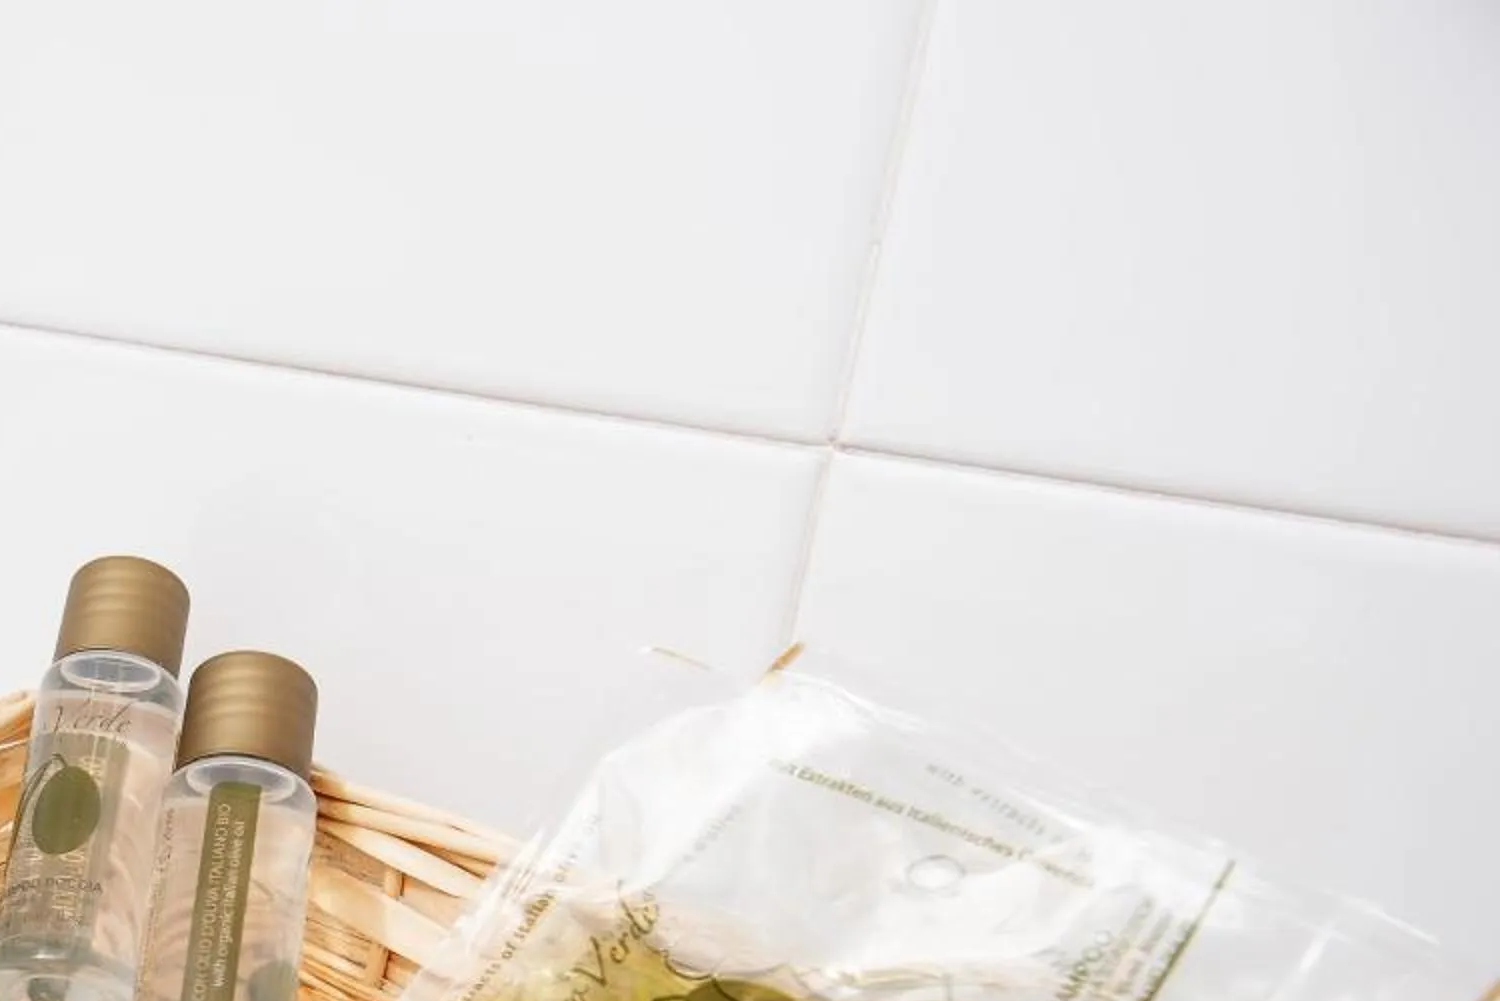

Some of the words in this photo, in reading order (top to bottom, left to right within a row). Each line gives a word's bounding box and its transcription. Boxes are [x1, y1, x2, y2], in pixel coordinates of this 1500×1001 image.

[216, 802, 231, 824] BIO
[208, 827, 227, 884] ITALIANO
[228, 838, 243, 866] olive
[215, 909, 236, 957] organic
[211, 957, 229, 987] with
